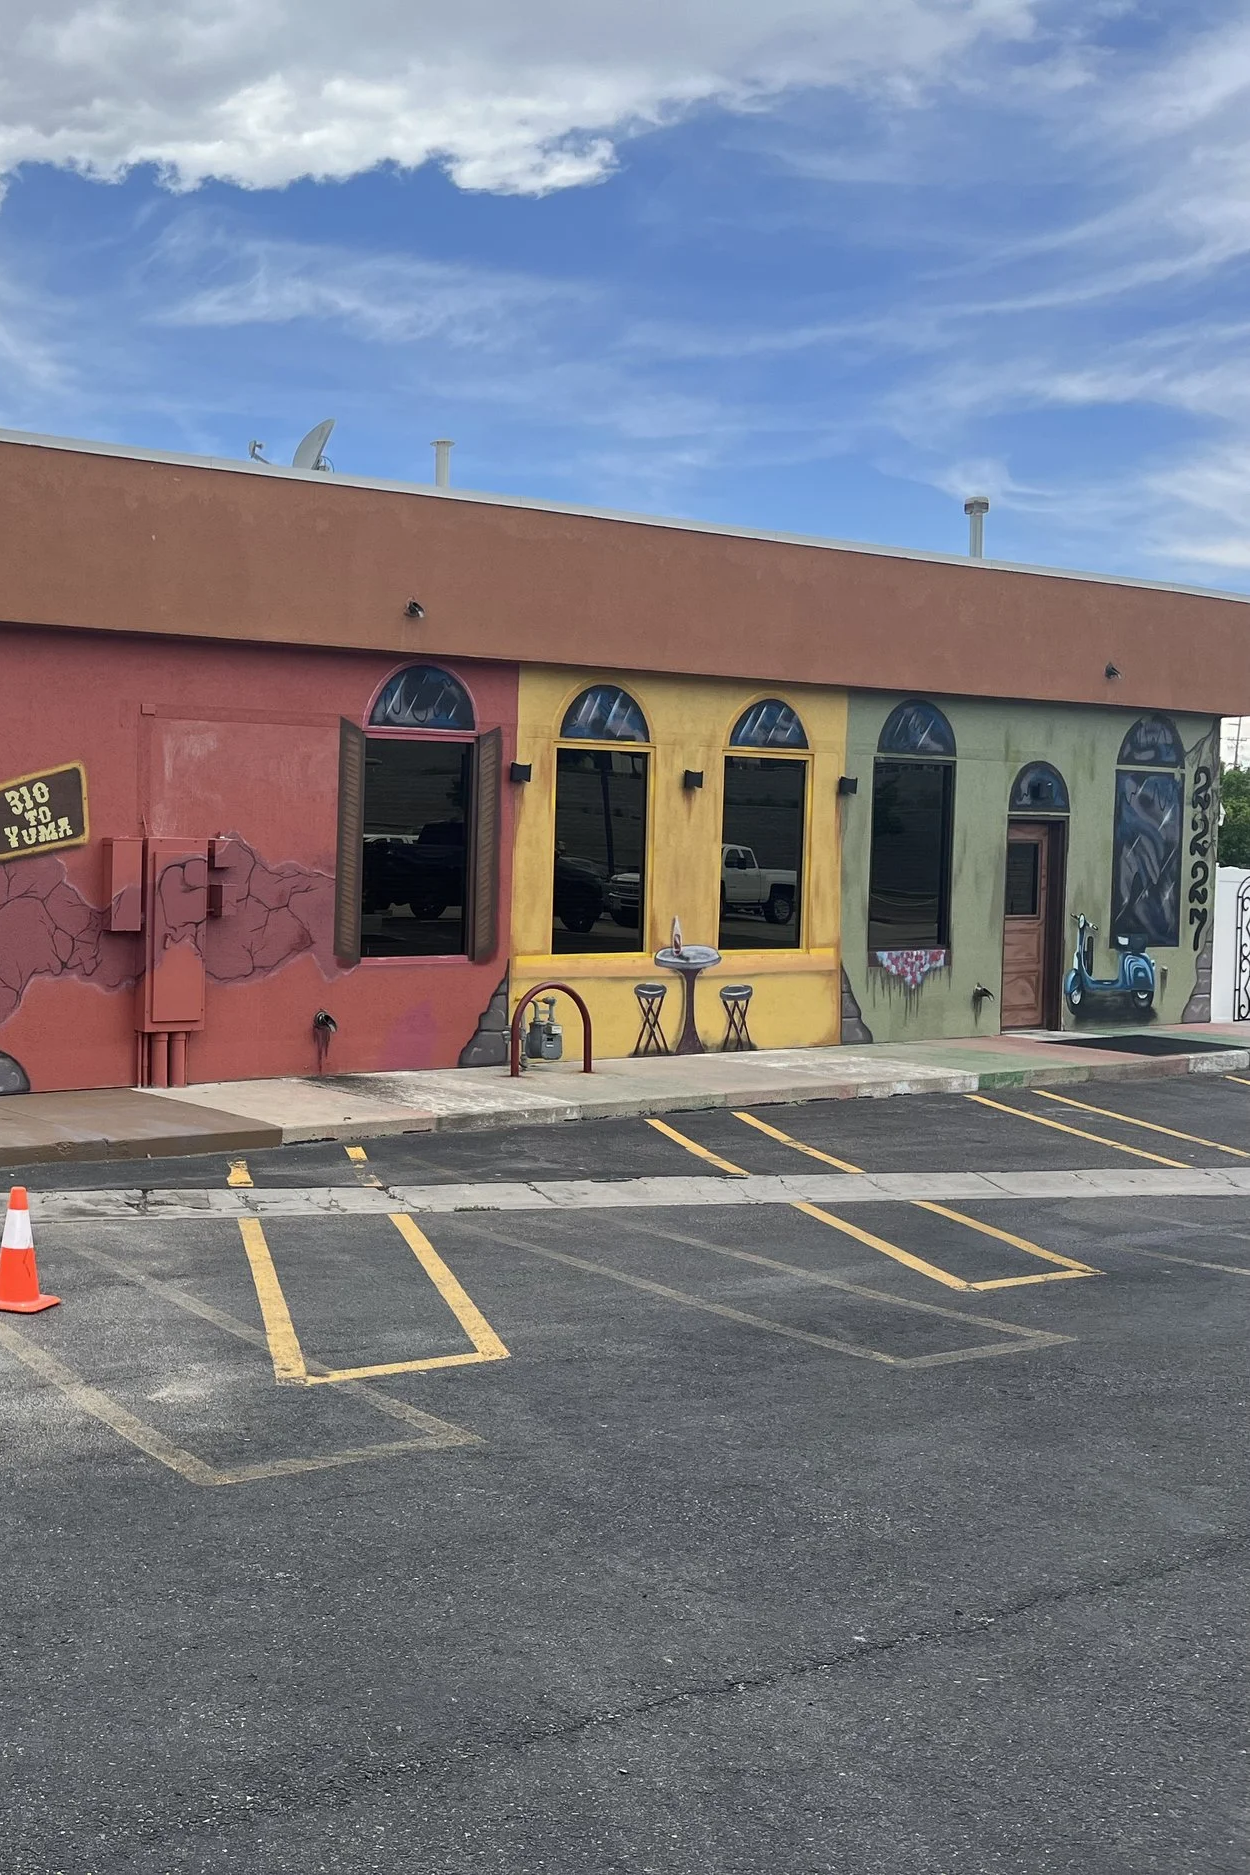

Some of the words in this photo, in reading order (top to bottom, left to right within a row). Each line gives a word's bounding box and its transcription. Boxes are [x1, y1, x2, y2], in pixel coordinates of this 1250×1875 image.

[4, 781, 50, 815] 310
[3, 816, 73, 848] YUMA
[24, 806, 51, 827] TO
[1189, 766, 1211, 952] 2227
